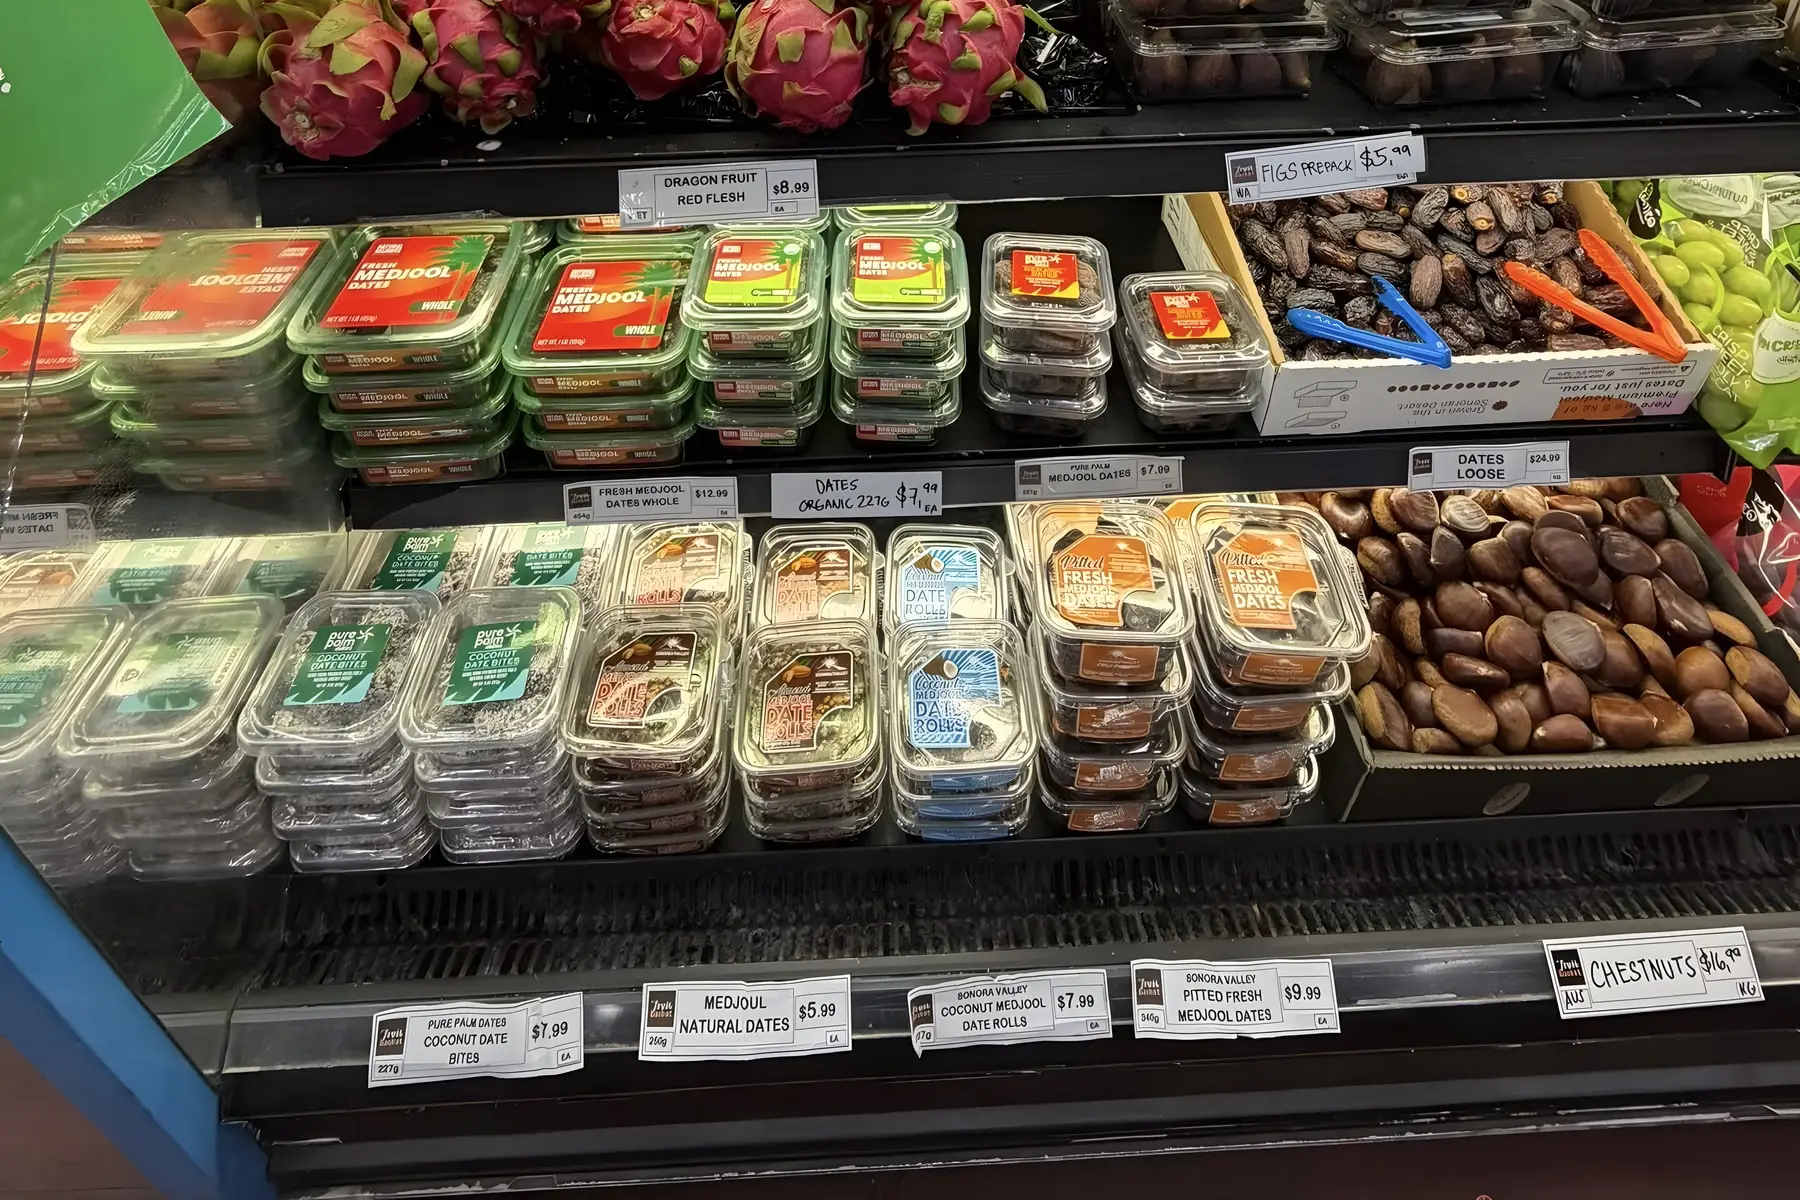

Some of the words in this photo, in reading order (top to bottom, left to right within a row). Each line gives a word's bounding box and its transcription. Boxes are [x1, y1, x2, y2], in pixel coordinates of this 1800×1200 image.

[1260, 161, 1298, 183] FIGS
[1301, 159, 1354, 177] PREPACK
[663, 174, 719, 188] DRAGON
[720, 172, 758, 185] FRUIT
[772, 179, 810, 195] $8.99
[677, 193, 704, 206] RED
[706, 191, 746, 204] FLESH
[1235, 185, 1252, 198] WA
[714, 262, 782, 272] MEDJOOL
[859, 260, 927, 270] MEDJOOL
[353, 266, 452, 281] MEDJOOL
[347, 280, 392, 290] DATES
[420, 300, 454, 311] WHOLE
[554, 291, 648, 306] MEDJOOL
[624, 324, 657, 335] WHOLE
[1590, 383, 1611, 392] for
[1615, 380, 1643, 392] just
[1645, 379, 1686, 389] Dates
[1619, 390, 1679, 400] Premium
[1458, 453, 1505, 465] DATES
[1048, 471, 1097, 483] MEDJOOL
[1099, 469, 1132, 481] DATES
[1457, 468, 1506, 480] LOOSE
[599, 487, 633, 497] FRESH
[635, 484, 685, 495] MEDJOOL
[815, 478, 860, 495] DATES
[605, 498, 640, 509] DATES
[642, 497, 680, 506] WHOLE
[798, 498, 854, 513] ORGANIC
[1060, 555, 1105, 569] Pitted
[1063, 570, 1113, 585] FRESH
[1226, 568, 1278, 585] FRESH
[905, 588, 946, 603] DATE
[1064, 583, 1116, 595] MEDJOOL
[1230, 583, 1283, 595] MEDJOOL
[1064, 594, 1118, 609] DATES
[1234, 594, 1288, 610] DATES
[904, 603, 947, 616] ROLLS
[468, 650, 517, 661] COCONUT
[766, 705, 813, 725] DATE
[1186, 973, 1224, 985] SONORA
[1224, 974, 1256, 985] VALLEY
[1589, 955, 1698, 989] CHESTNUTS
[957, 988, 995, 1001] SONORA
[996, 984, 1028, 998] VALLEY
[1183, 988, 1224, 1003] PITTED
[1225, 989, 1263, 1003] FRESH
[1284, 982, 1322, 1003] $9.99
[1564, 989, 1586, 1008] AUS
[1738, 982, 1757, 997] KG
[704, 995, 767, 1010] MEDJOUL
[940, 1002, 993, 1018] COCONUT
[995, 997, 1047, 1012] MEDJOOL
[1057, 992, 1095, 1011] $7.99
[798, 1001, 836, 1022] $5.99
[1178, 1008, 1235, 1023] MEDJOOL
[1235, 1008, 1272, 1023] DATES
[428, 1017, 453, 1030] PURE
[478, 1017, 507, 1028] DATES
[679, 1018, 743, 1034] NATURAL
[745, 1017, 790, 1033] DATES
[962, 1017, 991, 1032] DATE
[992, 1016, 1028, 1029] ROLLS
[531, 1021, 569, 1042] $7.99
[423, 1033, 477, 1048] COCONUT
[479, 1032, 508, 1045] DATE
[448, 1052, 480, 1065] BITES
